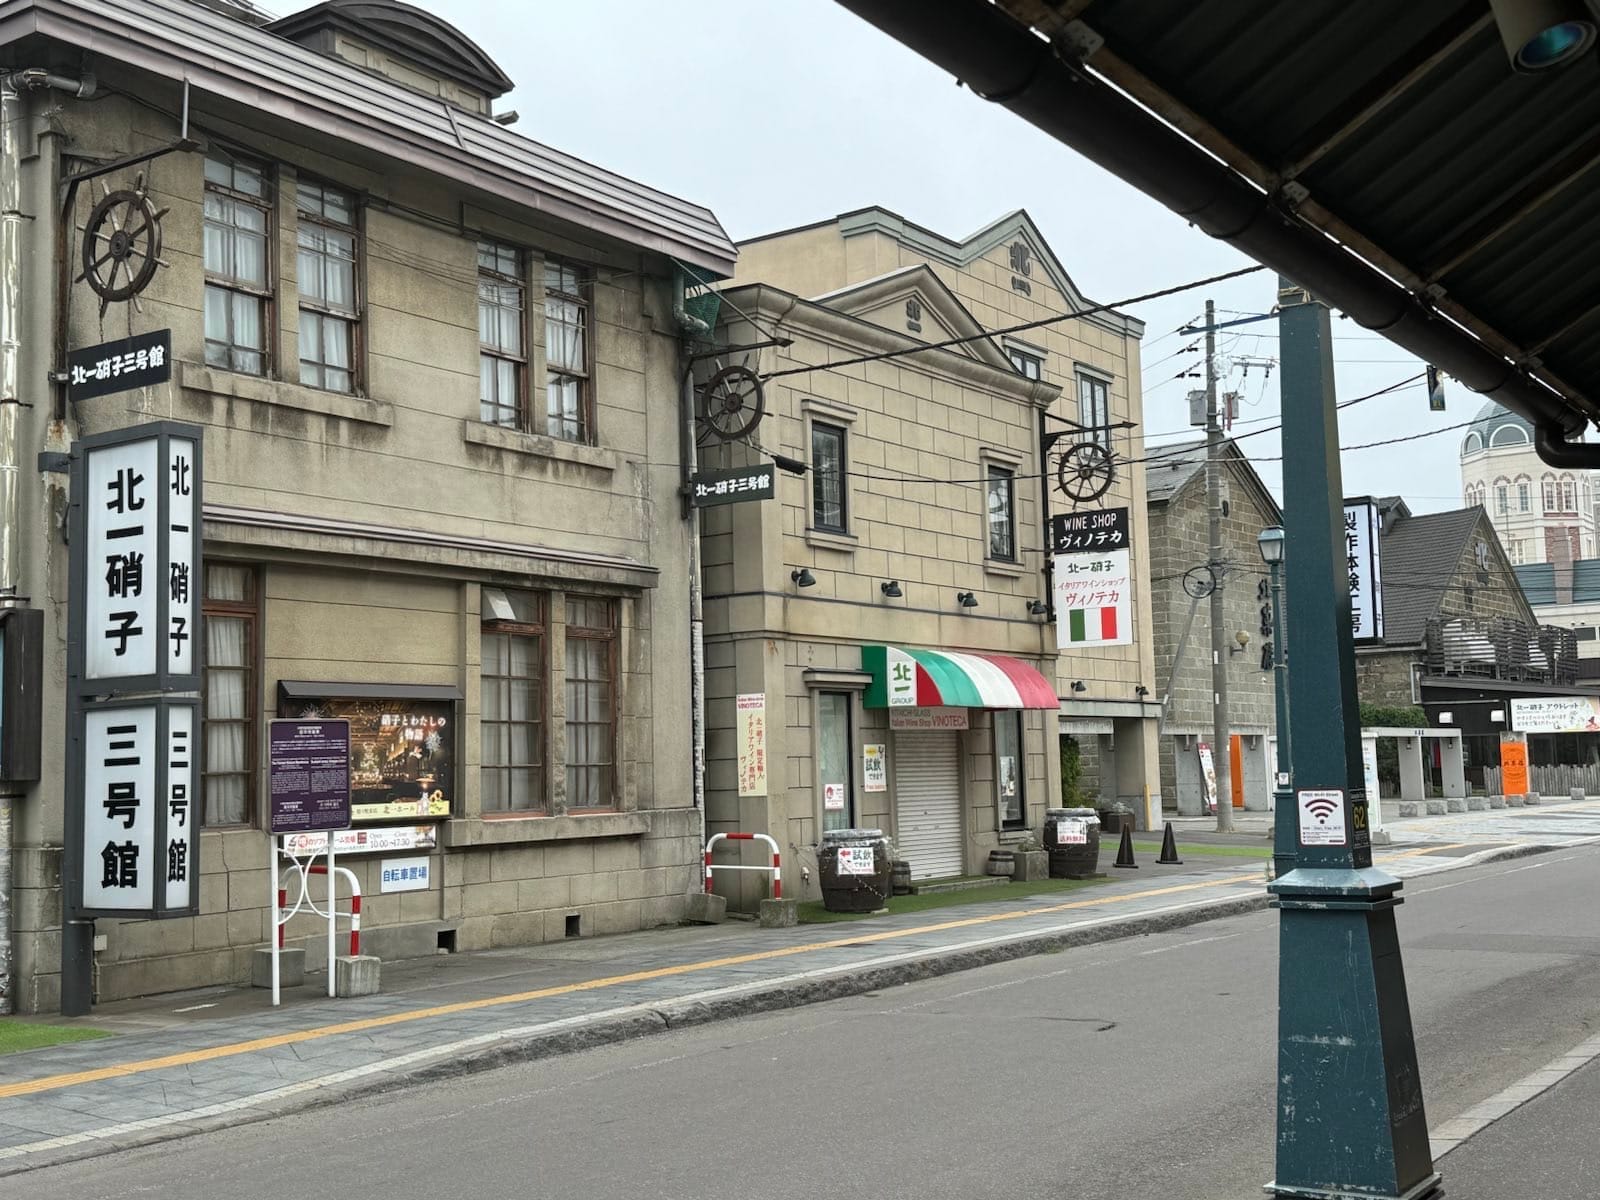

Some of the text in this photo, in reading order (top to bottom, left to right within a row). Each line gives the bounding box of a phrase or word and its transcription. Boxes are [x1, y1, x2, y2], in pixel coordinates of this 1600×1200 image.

[71, 345, 165, 385] 北一硝子三号館
[695, 474, 770, 497] 北一硝子三号館
[1064, 513, 1117, 531] WINE SHOP
[1060, 530, 1122, 549] ヴィノテカ
[105, 467, 145, 656] 北一硝子
[171, 455, 190, 657] 北一硝子
[1067, 560, 1115, 574] 北一硝子
[1058, 577, 1126, 591] イタリアワインショップ
[1065, 591, 1120, 607] ヴィノテカ
[892, 662, 912, 692] 北一
[101, 725, 141, 888] 三号館
[168, 731, 189, 882] 三号館
[1353, 805, 1366, 829] 62
[383, 866, 427, 882] 自転車置場
